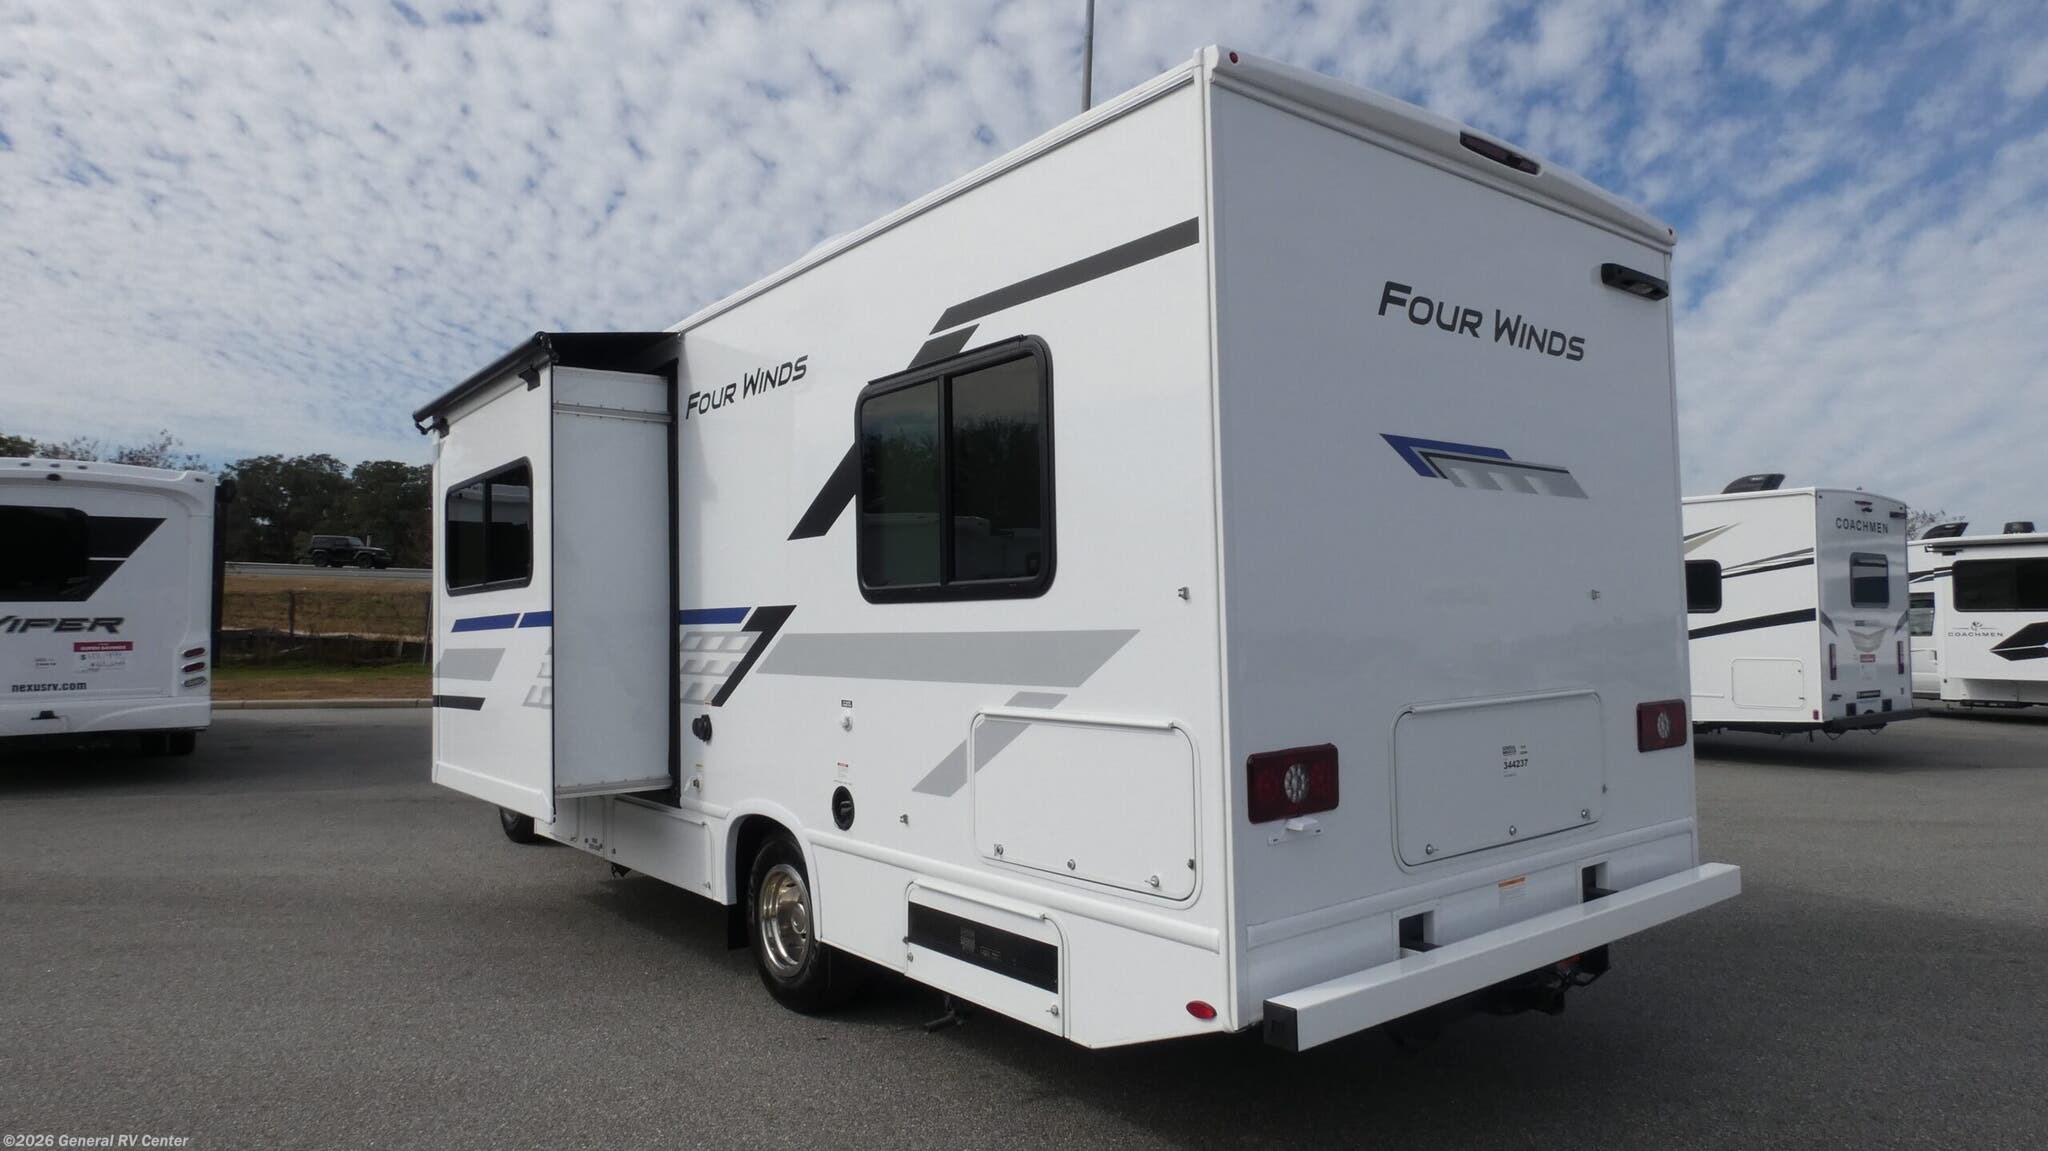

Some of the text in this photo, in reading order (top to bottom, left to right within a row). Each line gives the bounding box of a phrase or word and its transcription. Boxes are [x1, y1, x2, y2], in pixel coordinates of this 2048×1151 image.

[1378, 280, 1585, 362] FOUR WINDS
[685, 355, 809, 420] FOUR WINDS
[1835, 517, 1889, 534] COACHMEN
[12, 682, 87, 692] nexusrv.com
